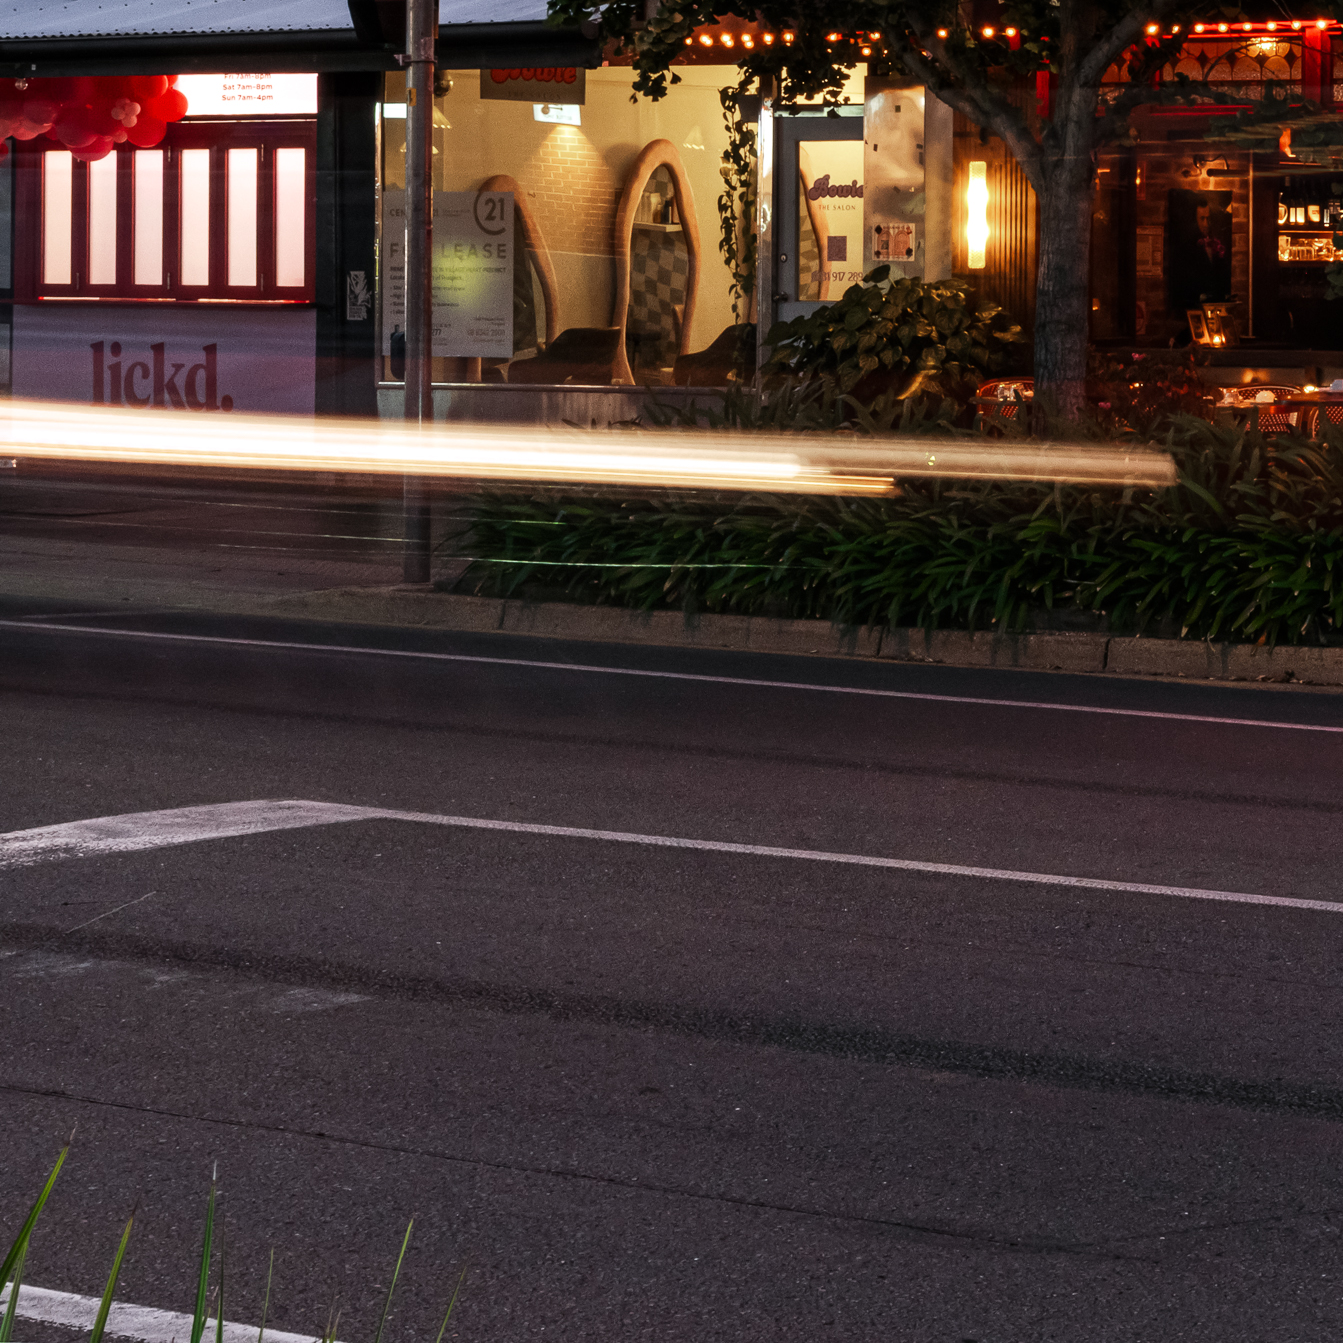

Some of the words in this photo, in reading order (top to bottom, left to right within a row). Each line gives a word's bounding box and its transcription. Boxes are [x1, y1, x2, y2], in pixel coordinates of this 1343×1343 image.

[484, 197, 505, 221] 21
[441, 243, 507, 259] LEASE
[90, 340, 234, 412] lickd.
